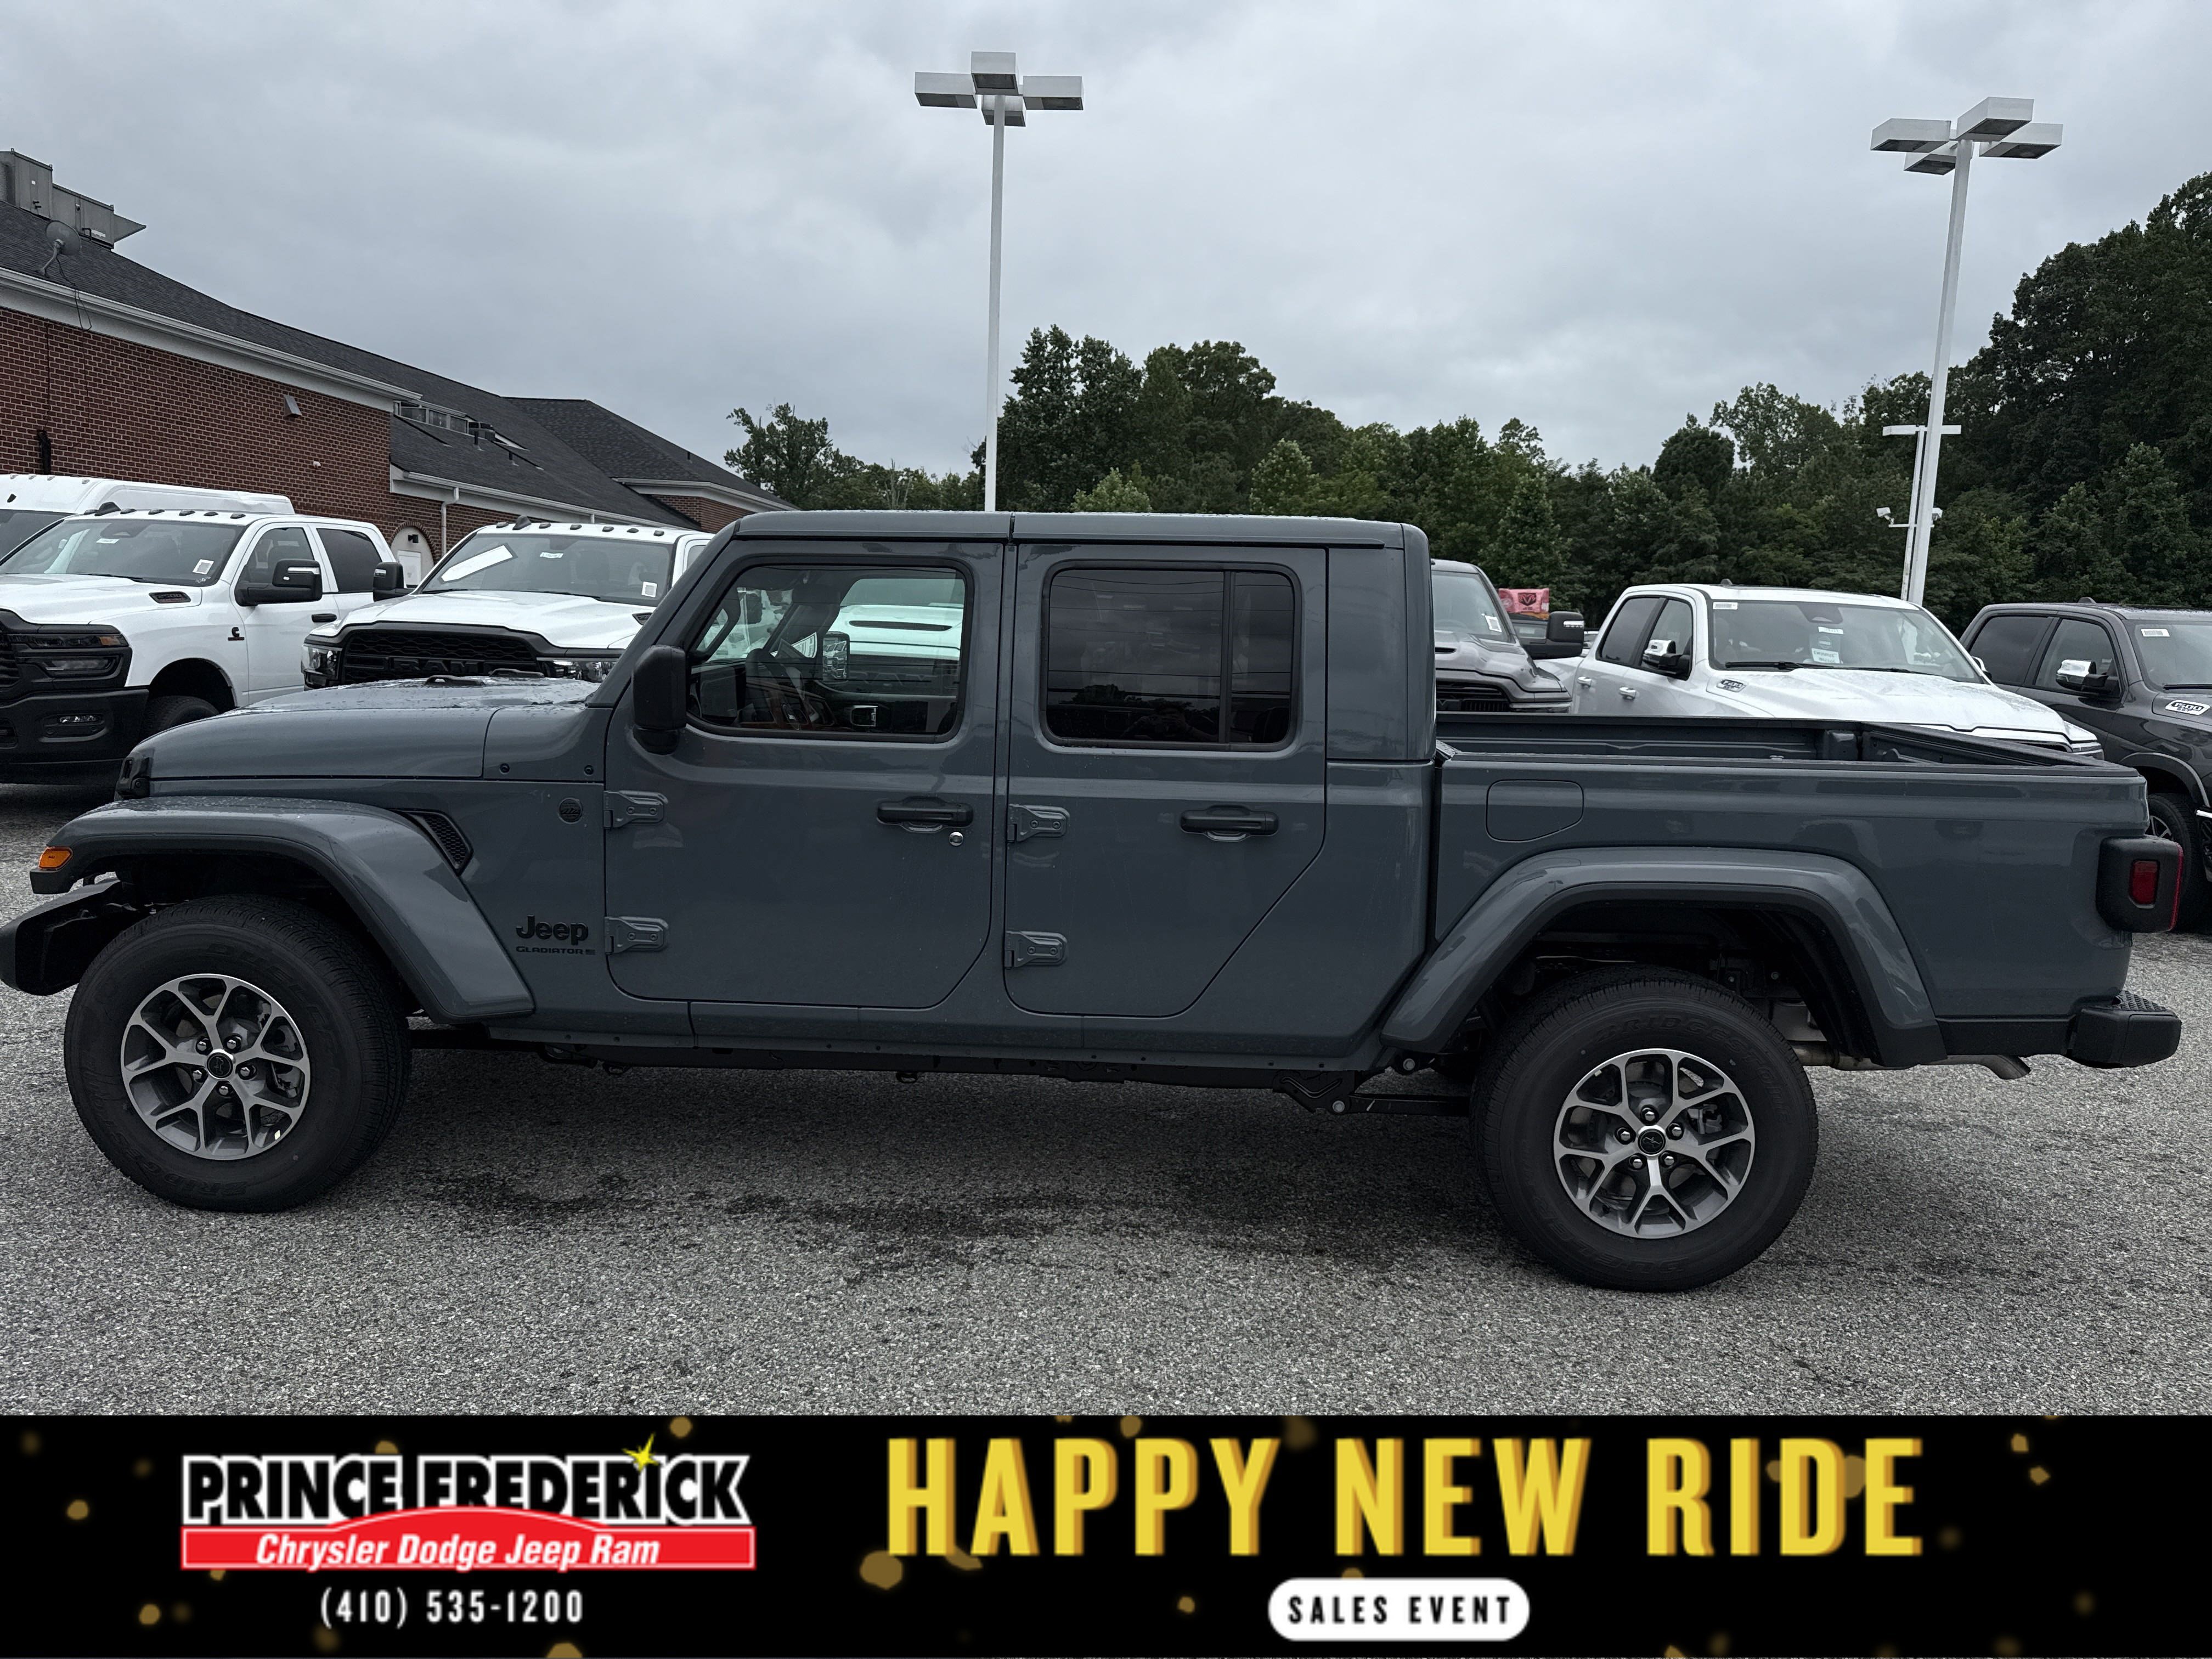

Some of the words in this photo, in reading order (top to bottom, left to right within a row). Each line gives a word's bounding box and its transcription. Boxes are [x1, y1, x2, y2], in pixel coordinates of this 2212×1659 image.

[2174, 702, 2203, 712] 1500
[516, 915, 589, 946] Jeep
[516, 946, 583, 955] GLADIATOR
